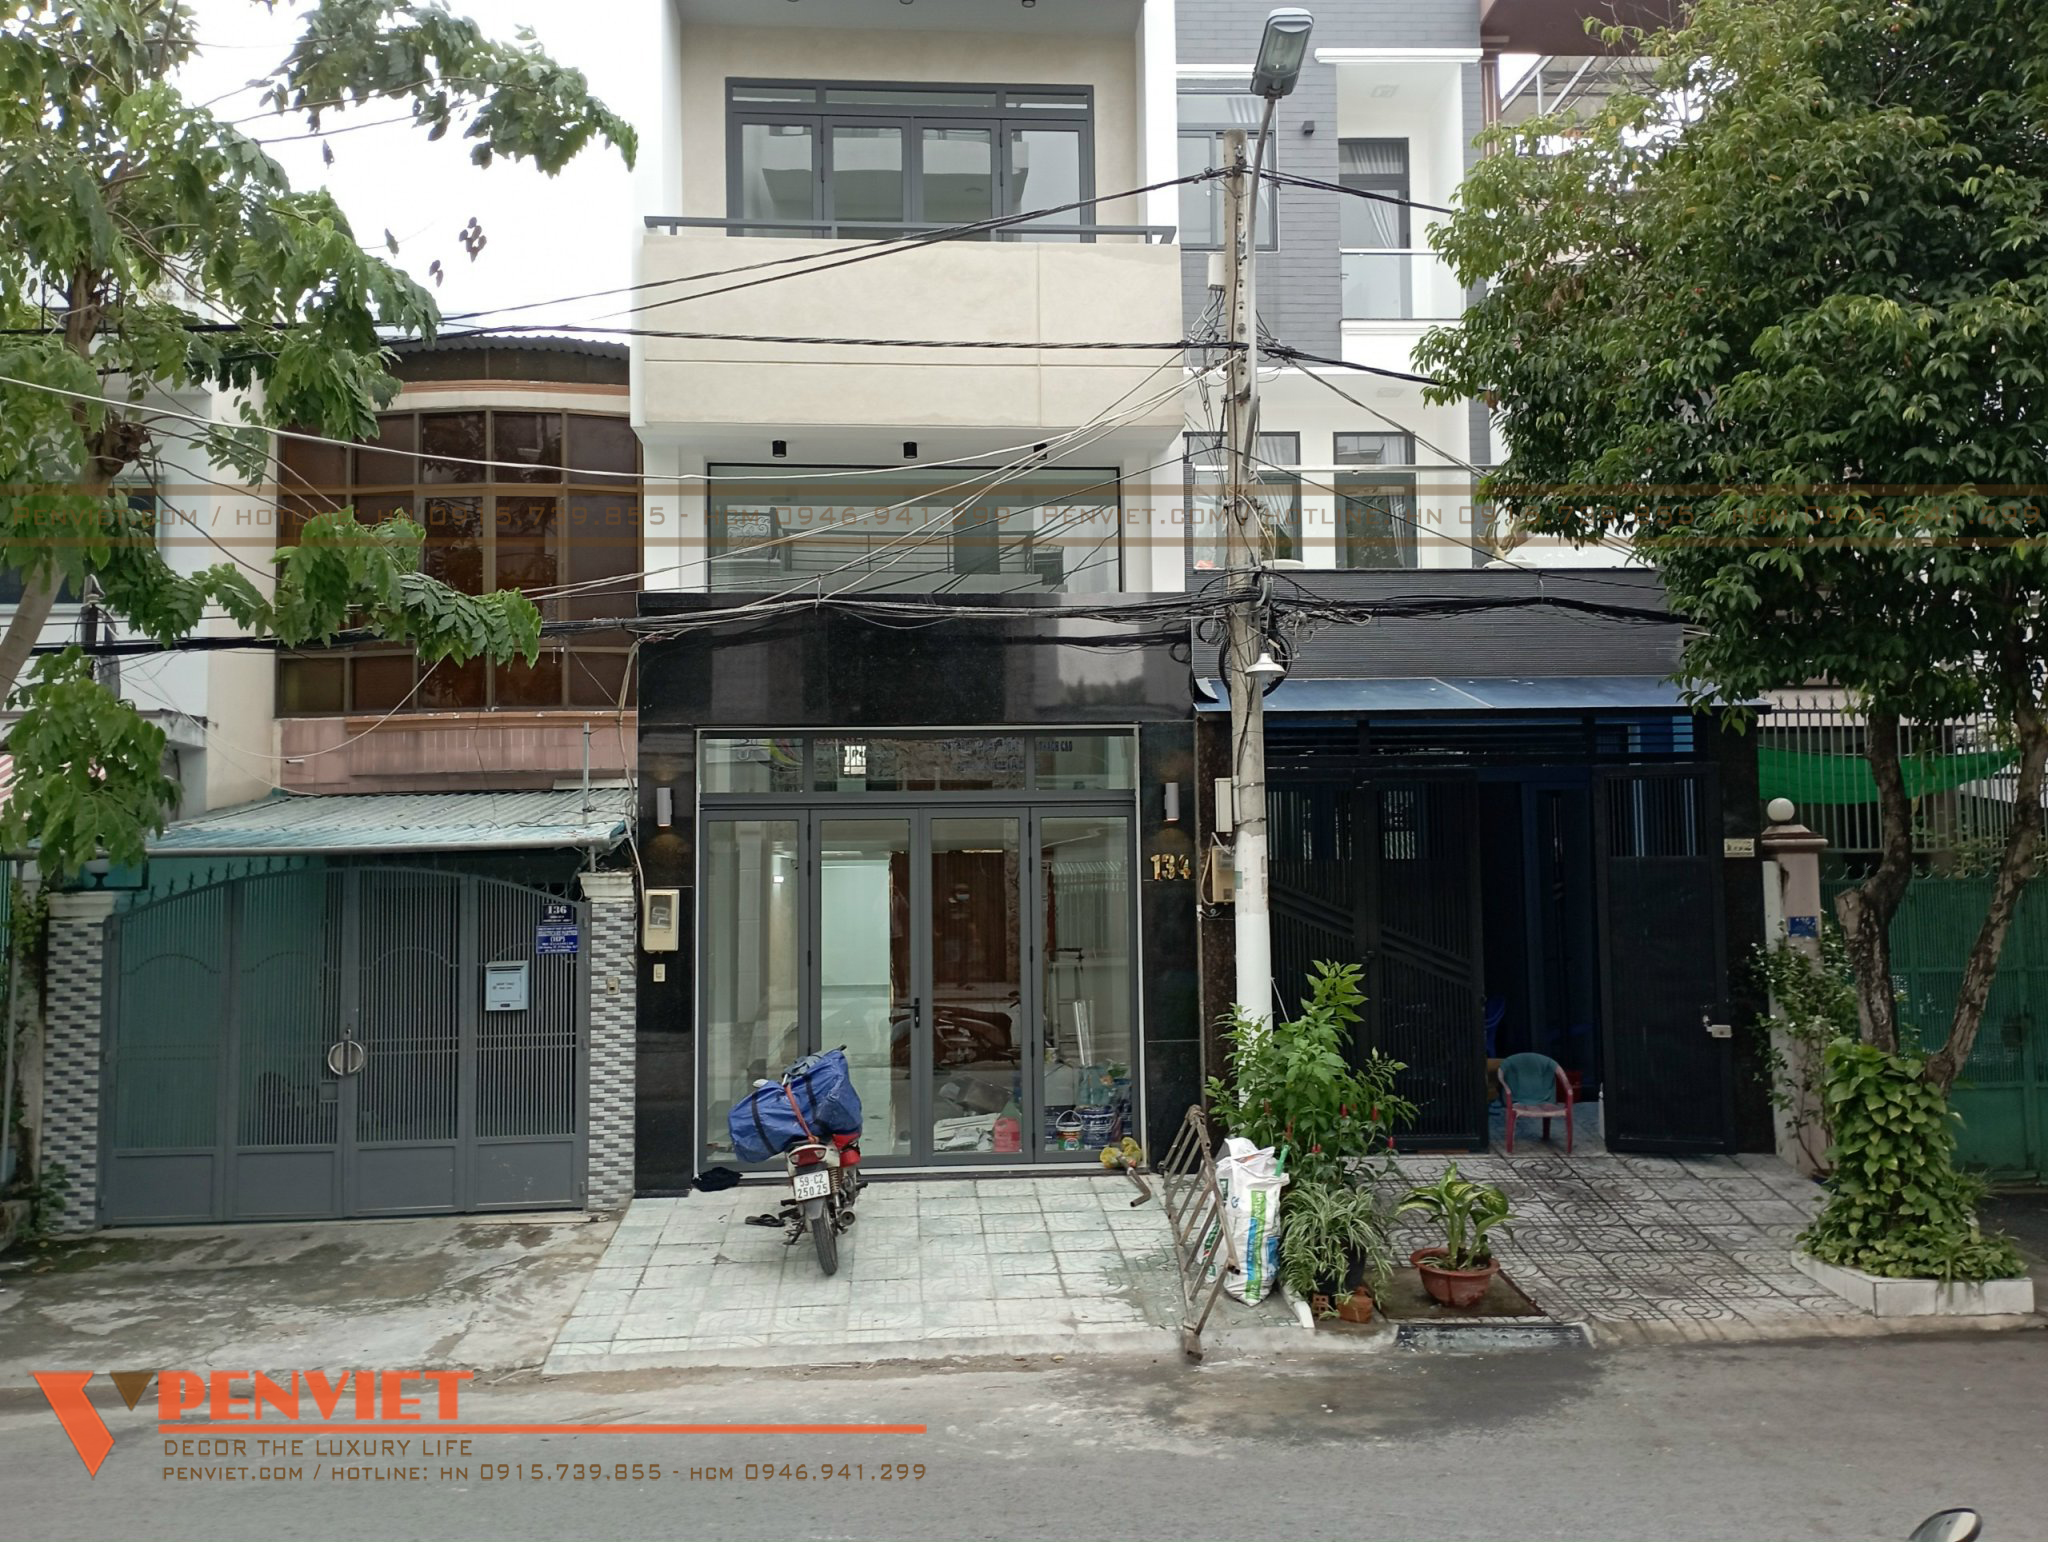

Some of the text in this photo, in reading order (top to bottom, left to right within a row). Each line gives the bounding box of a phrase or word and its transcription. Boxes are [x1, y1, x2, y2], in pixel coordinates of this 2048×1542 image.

[1151, 854, 1191, 880] 134
[548, 905, 567, 914] 136
[799, 1173, 824, 1187] 59-C2
